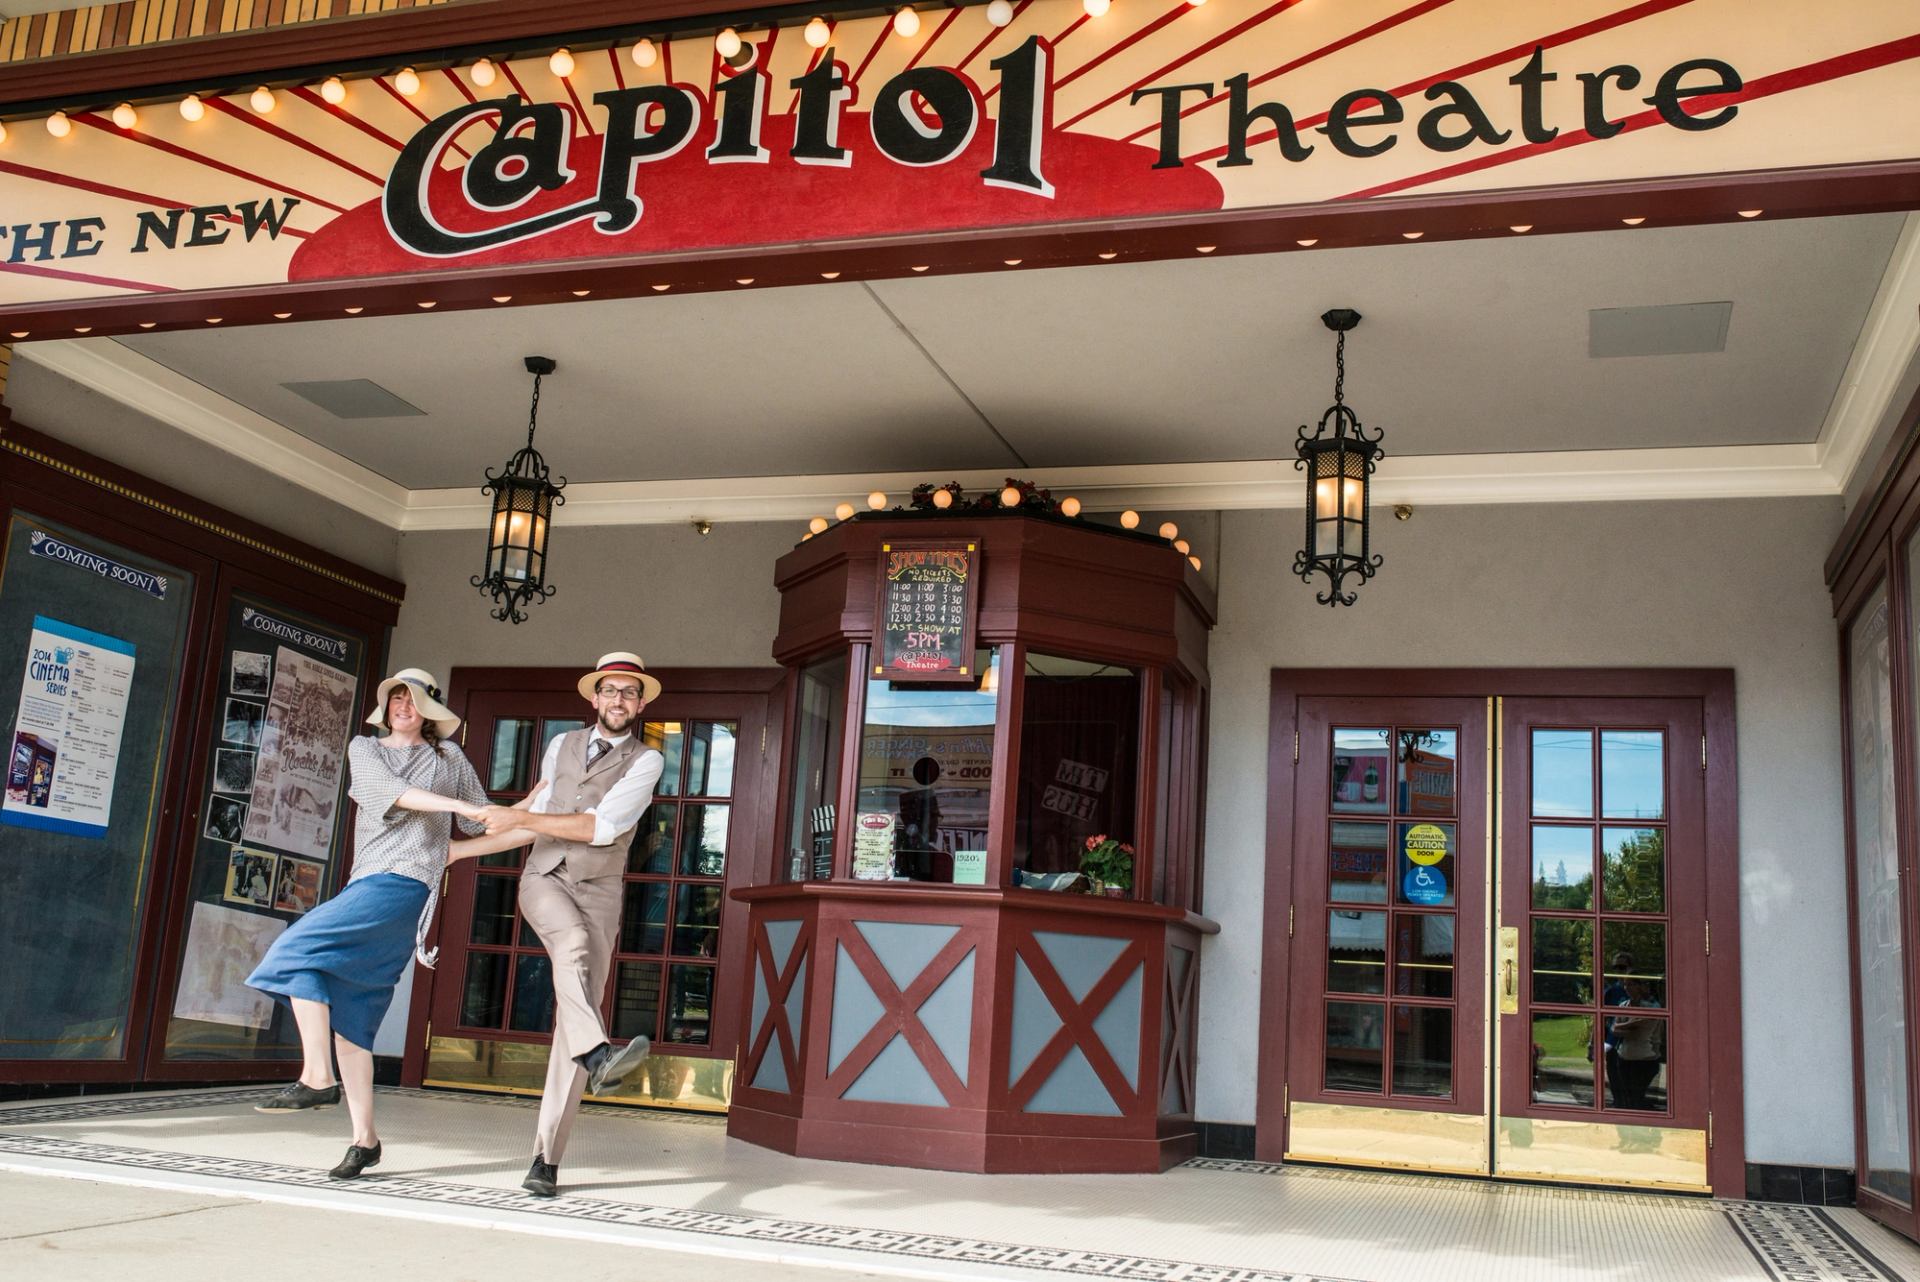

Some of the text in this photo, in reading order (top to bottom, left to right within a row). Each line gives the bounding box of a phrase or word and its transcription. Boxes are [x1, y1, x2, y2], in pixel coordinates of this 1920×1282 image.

[131, 197, 301, 253] NEW
[382, 35, 1056, 258] Capitol
[1130, 45, 1744, 170] Theatre
[45, 541, 155, 592] COMING SOON!
[888, 551, 968, 575] SHOW TIMES
[922, 568, 951, 577] TICKETS
[911, 575, 952, 583] REQUIRED
[893, 582, 963, 593] 11:00 1:00 3:00
[892, 591, 962, 604] 11:30 1:30 3:30
[891, 602, 962, 614] 12:00 2:00 4:00
[890, 613, 962, 624] 12:30 2:30 4:30
[886, 623, 962, 635] LAST SHOW AT
[253, 616, 338, 655] COMING SOON!
[33, 649, 51, 663] 2014
[906, 661, 939, 669] Theatre
[30, 661, 70, 683] CINEMA
[46, 682, 68, 697] SERIES
[1407, 840, 1445, 849] CAUTION
